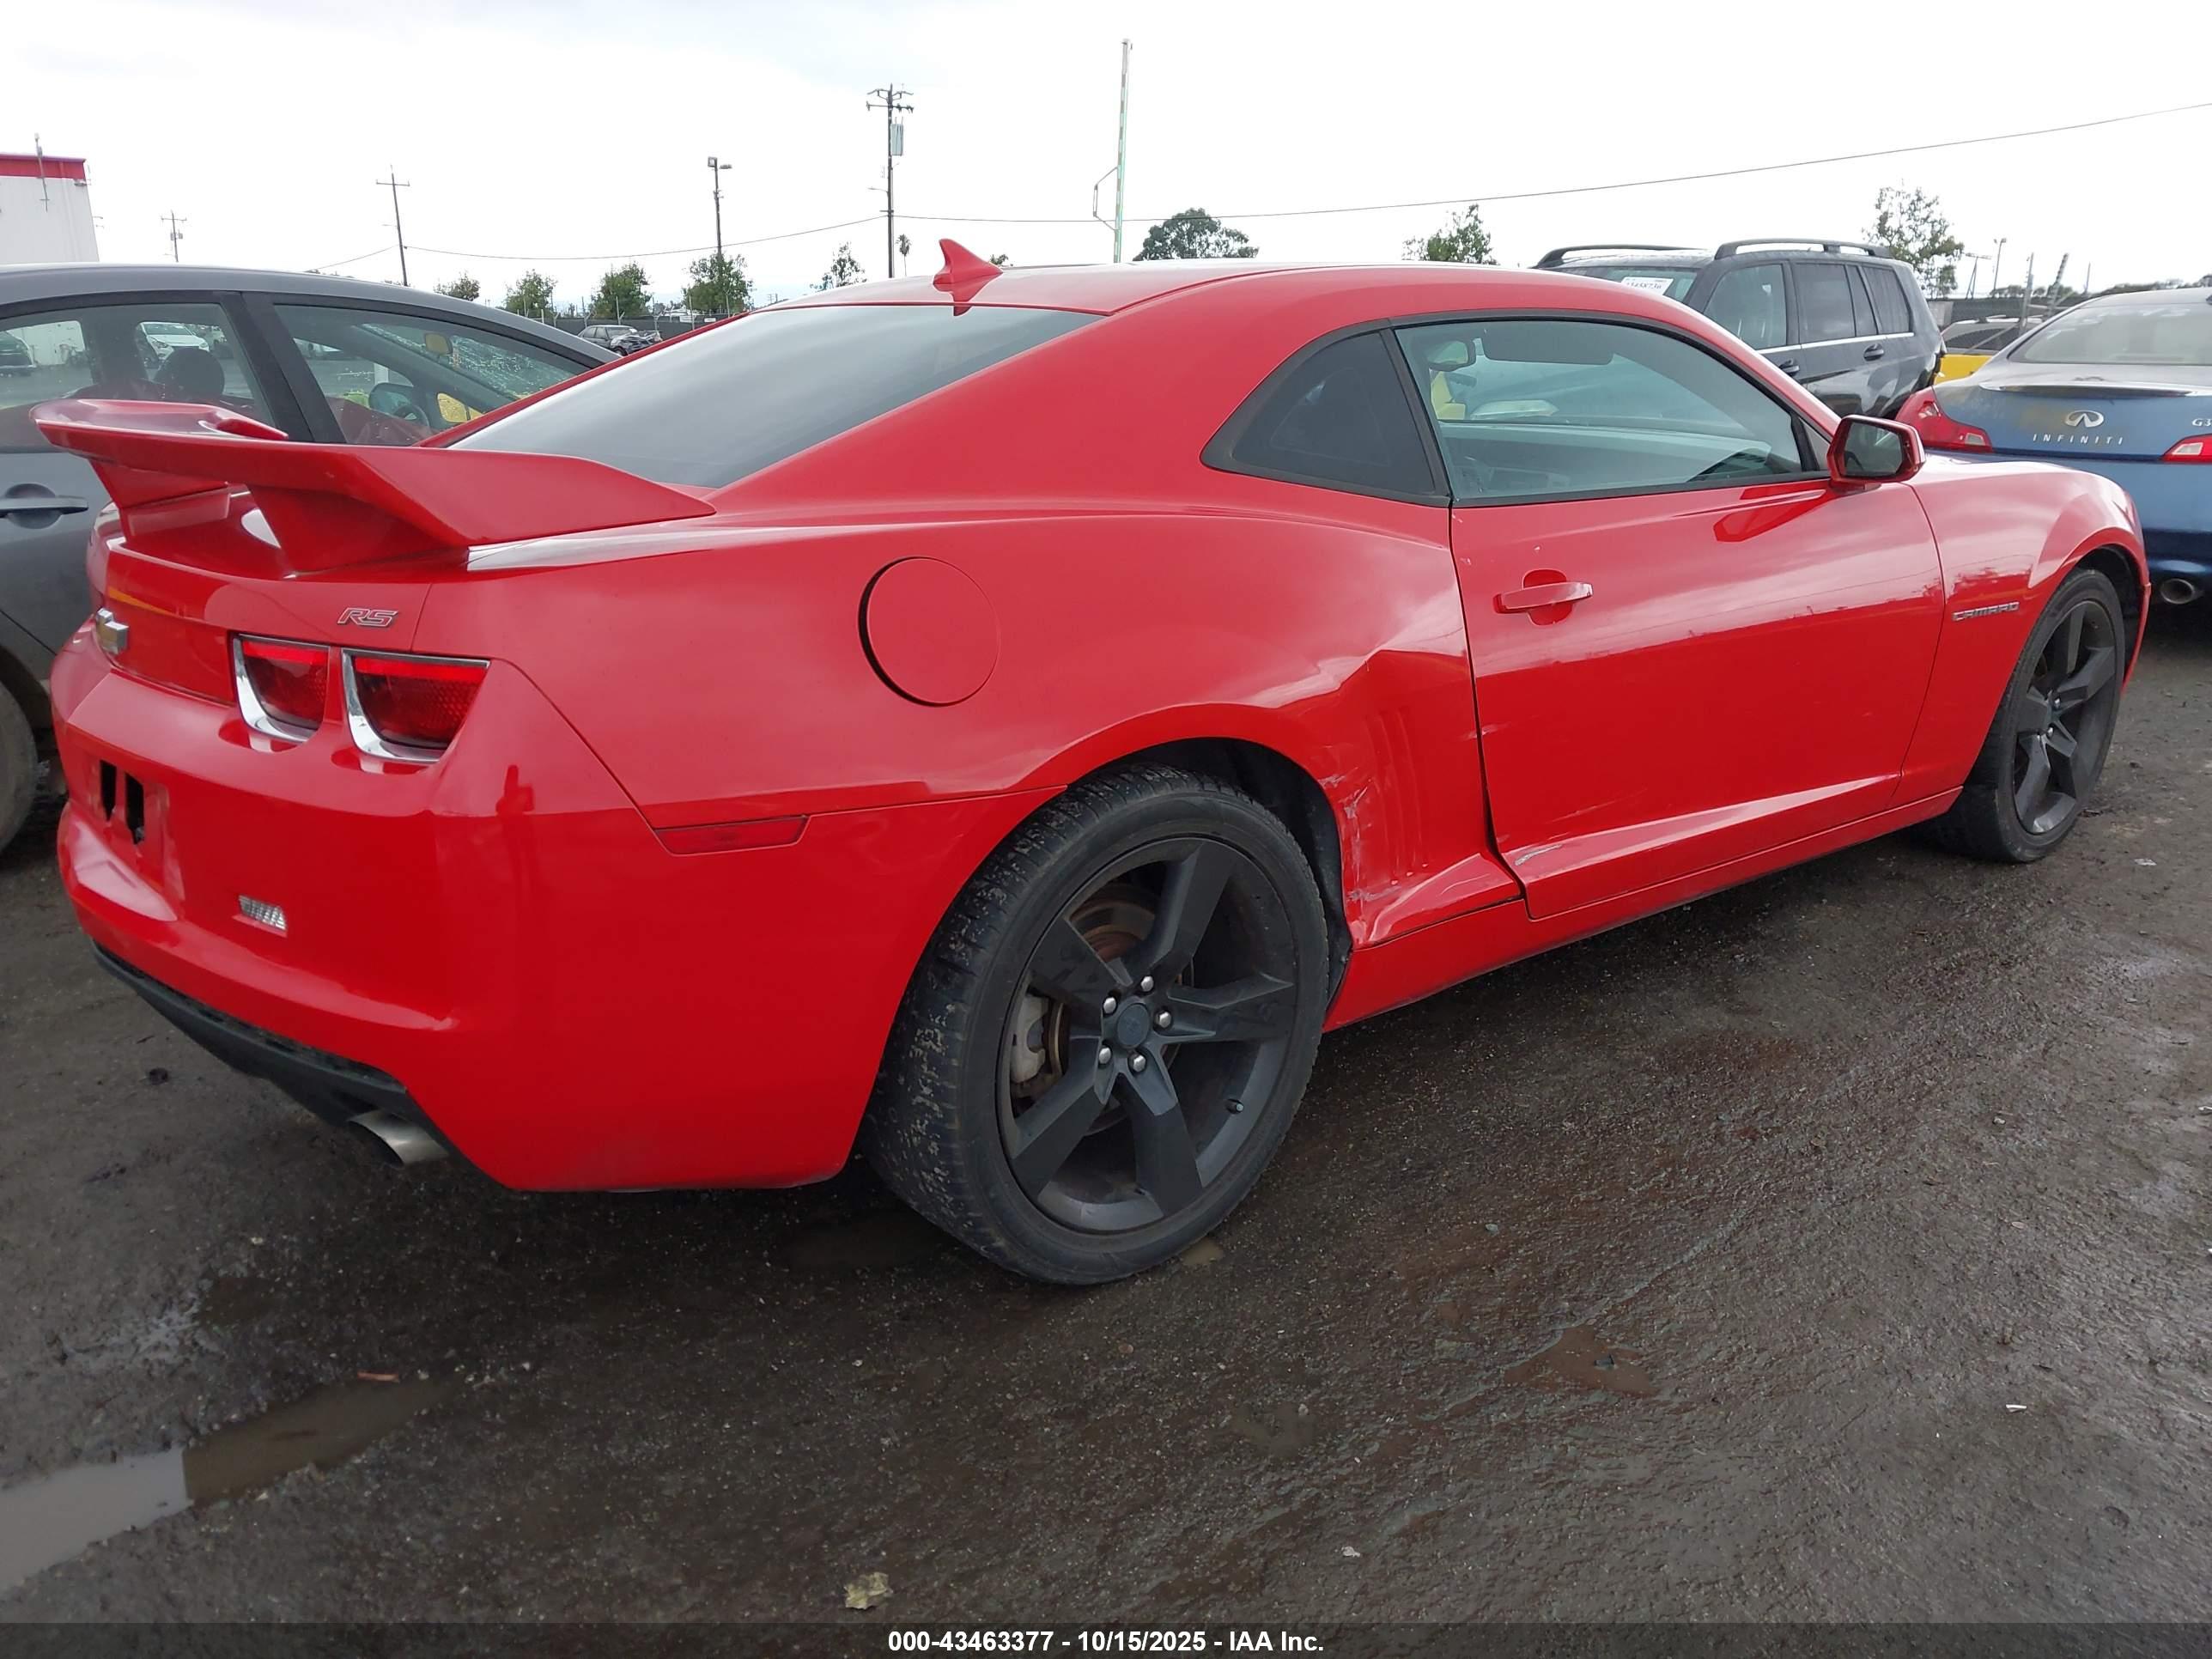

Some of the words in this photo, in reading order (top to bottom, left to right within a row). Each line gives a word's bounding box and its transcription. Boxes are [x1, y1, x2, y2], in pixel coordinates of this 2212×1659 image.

[2033, 434, 2124, 446] INFINITI
[337, 607, 398, 628] RS
[1953, 601, 2020, 622] CAMARO
